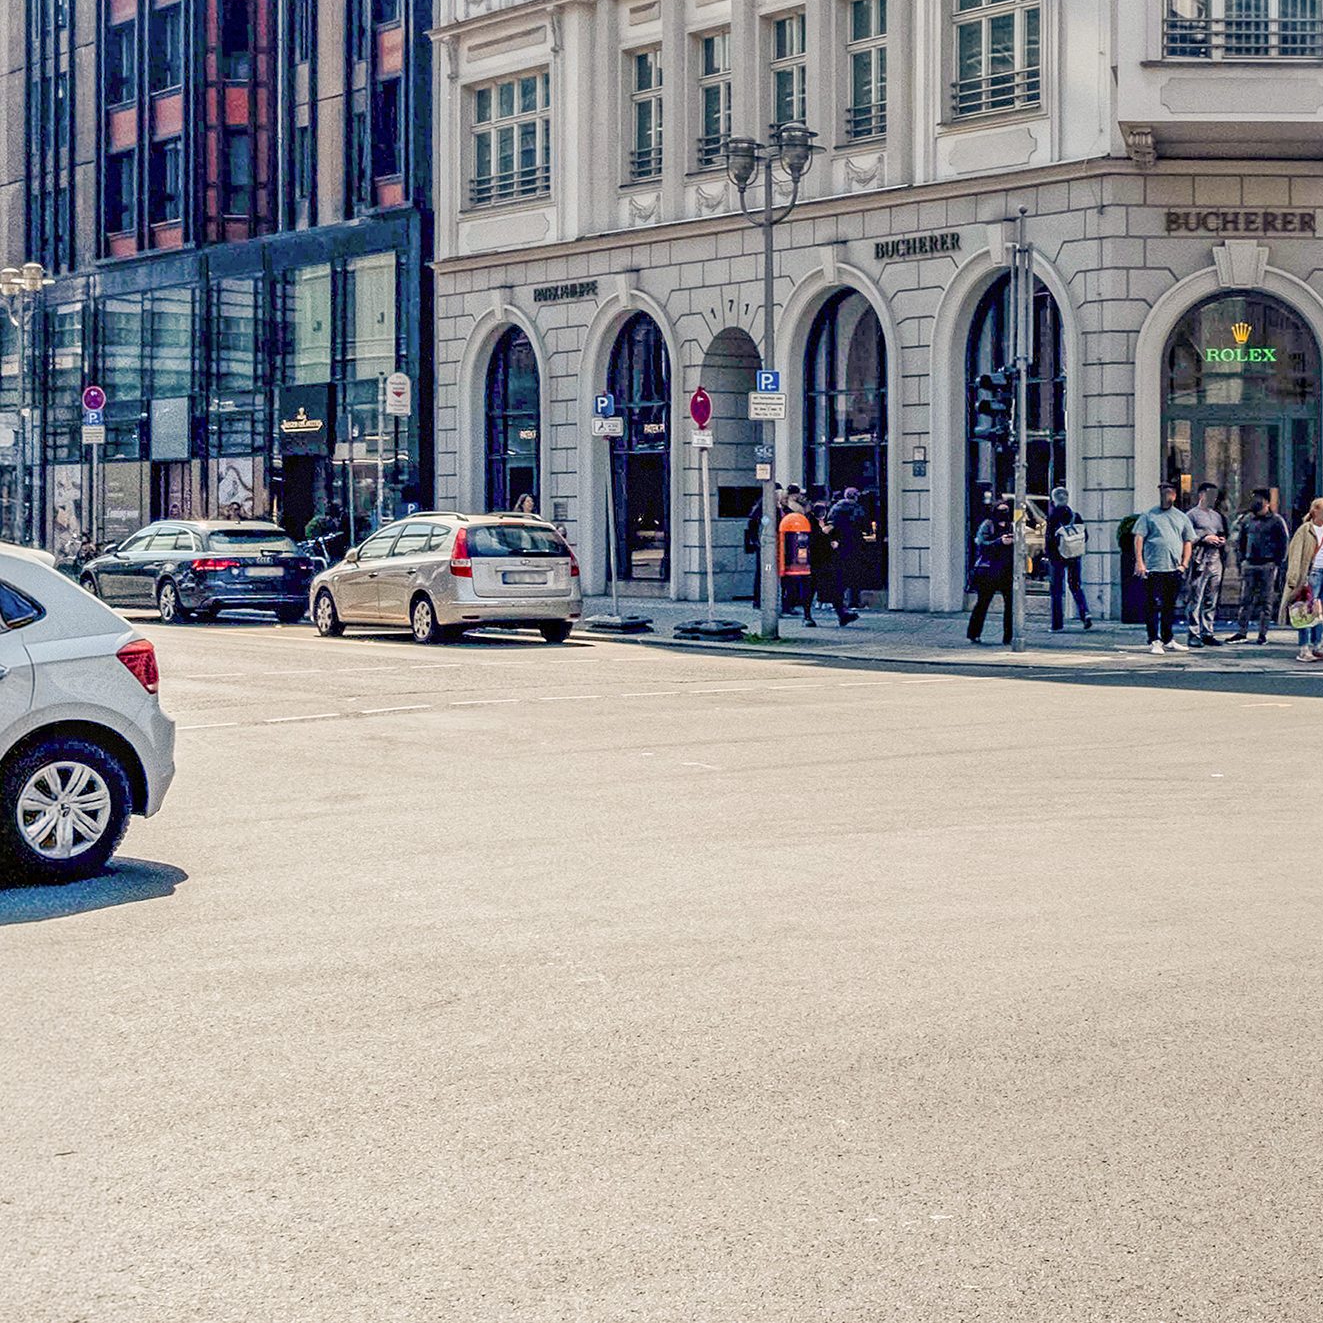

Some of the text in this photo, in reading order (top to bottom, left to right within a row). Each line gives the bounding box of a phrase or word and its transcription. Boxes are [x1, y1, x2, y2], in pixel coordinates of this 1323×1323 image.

[1165, 211, 1316, 232] BUCHERER
[874, 232, 961, 259] BUCHERER
[1205, 348, 1277, 362] ROLEX
[761, 373, 774, 390] P
[597, 397, 608, 413] P
[89, 413, 98, 424] P
[408, 503, 416, 514] P
